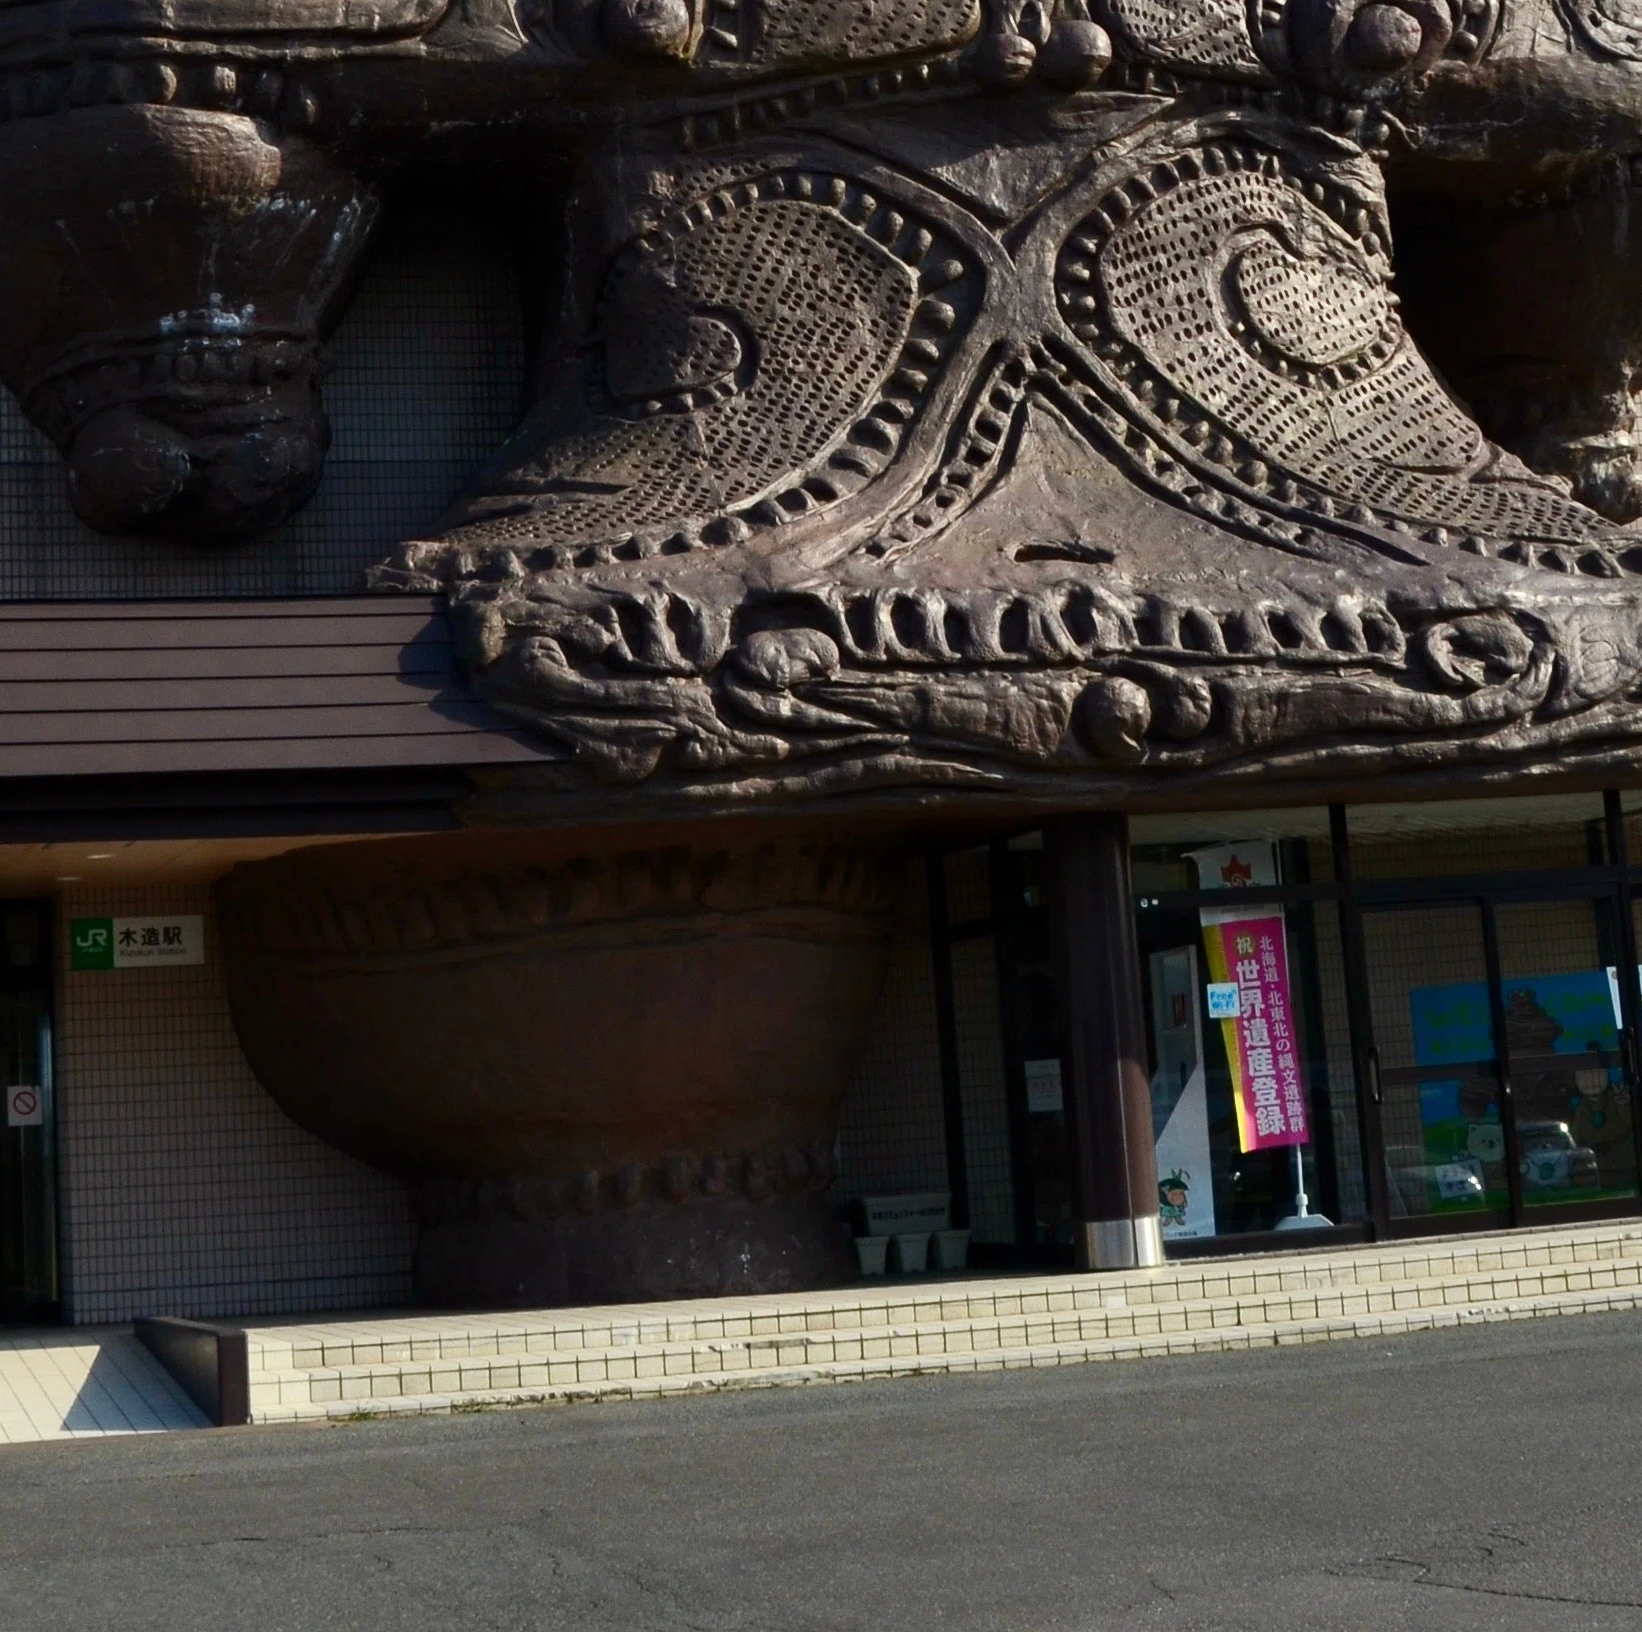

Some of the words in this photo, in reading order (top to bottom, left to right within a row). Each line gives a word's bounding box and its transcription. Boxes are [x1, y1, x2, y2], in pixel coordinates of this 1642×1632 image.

[76, 928, 108, 948] JR
[118, 926, 183, 947] 木造駅
[1236, 935, 1254, 955] 祝
[1236, 959, 1286, 1137] 世界遺産登録
